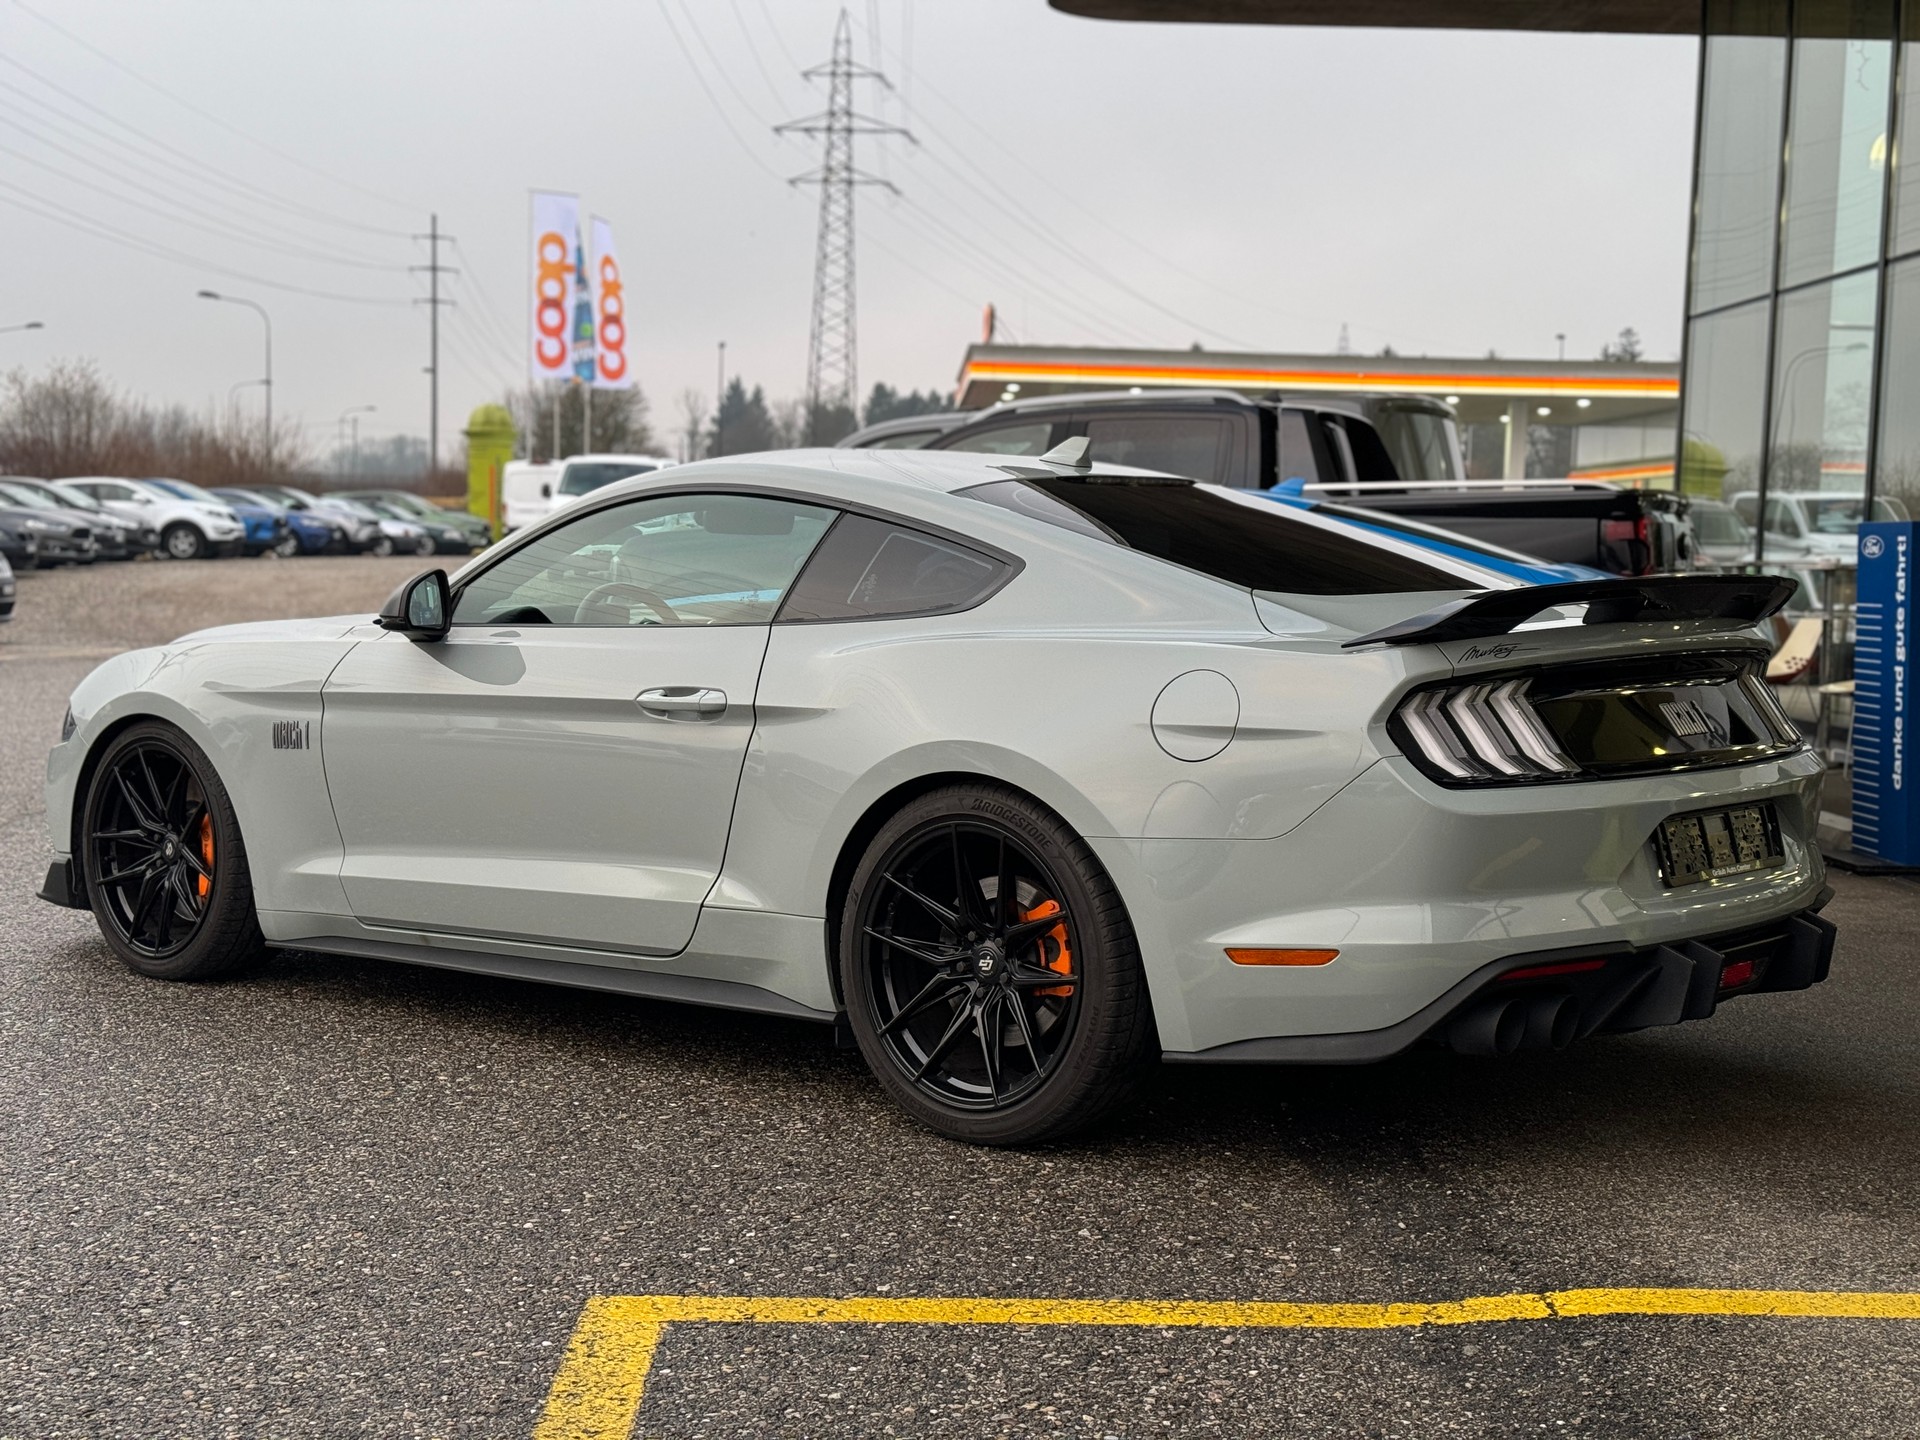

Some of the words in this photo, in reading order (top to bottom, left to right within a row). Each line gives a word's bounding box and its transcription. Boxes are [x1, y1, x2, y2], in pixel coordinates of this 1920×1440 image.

[537, 232, 576, 370] coop
[599, 254, 626, 380] coop
[1895, 535, 1907, 603] fahrt!
[1894, 607, 1906, 662] gute
[1893, 666, 1904, 712] und
[1892, 716, 1903, 790] danke
[970, 797, 1054, 850] BRIDGESTONE
